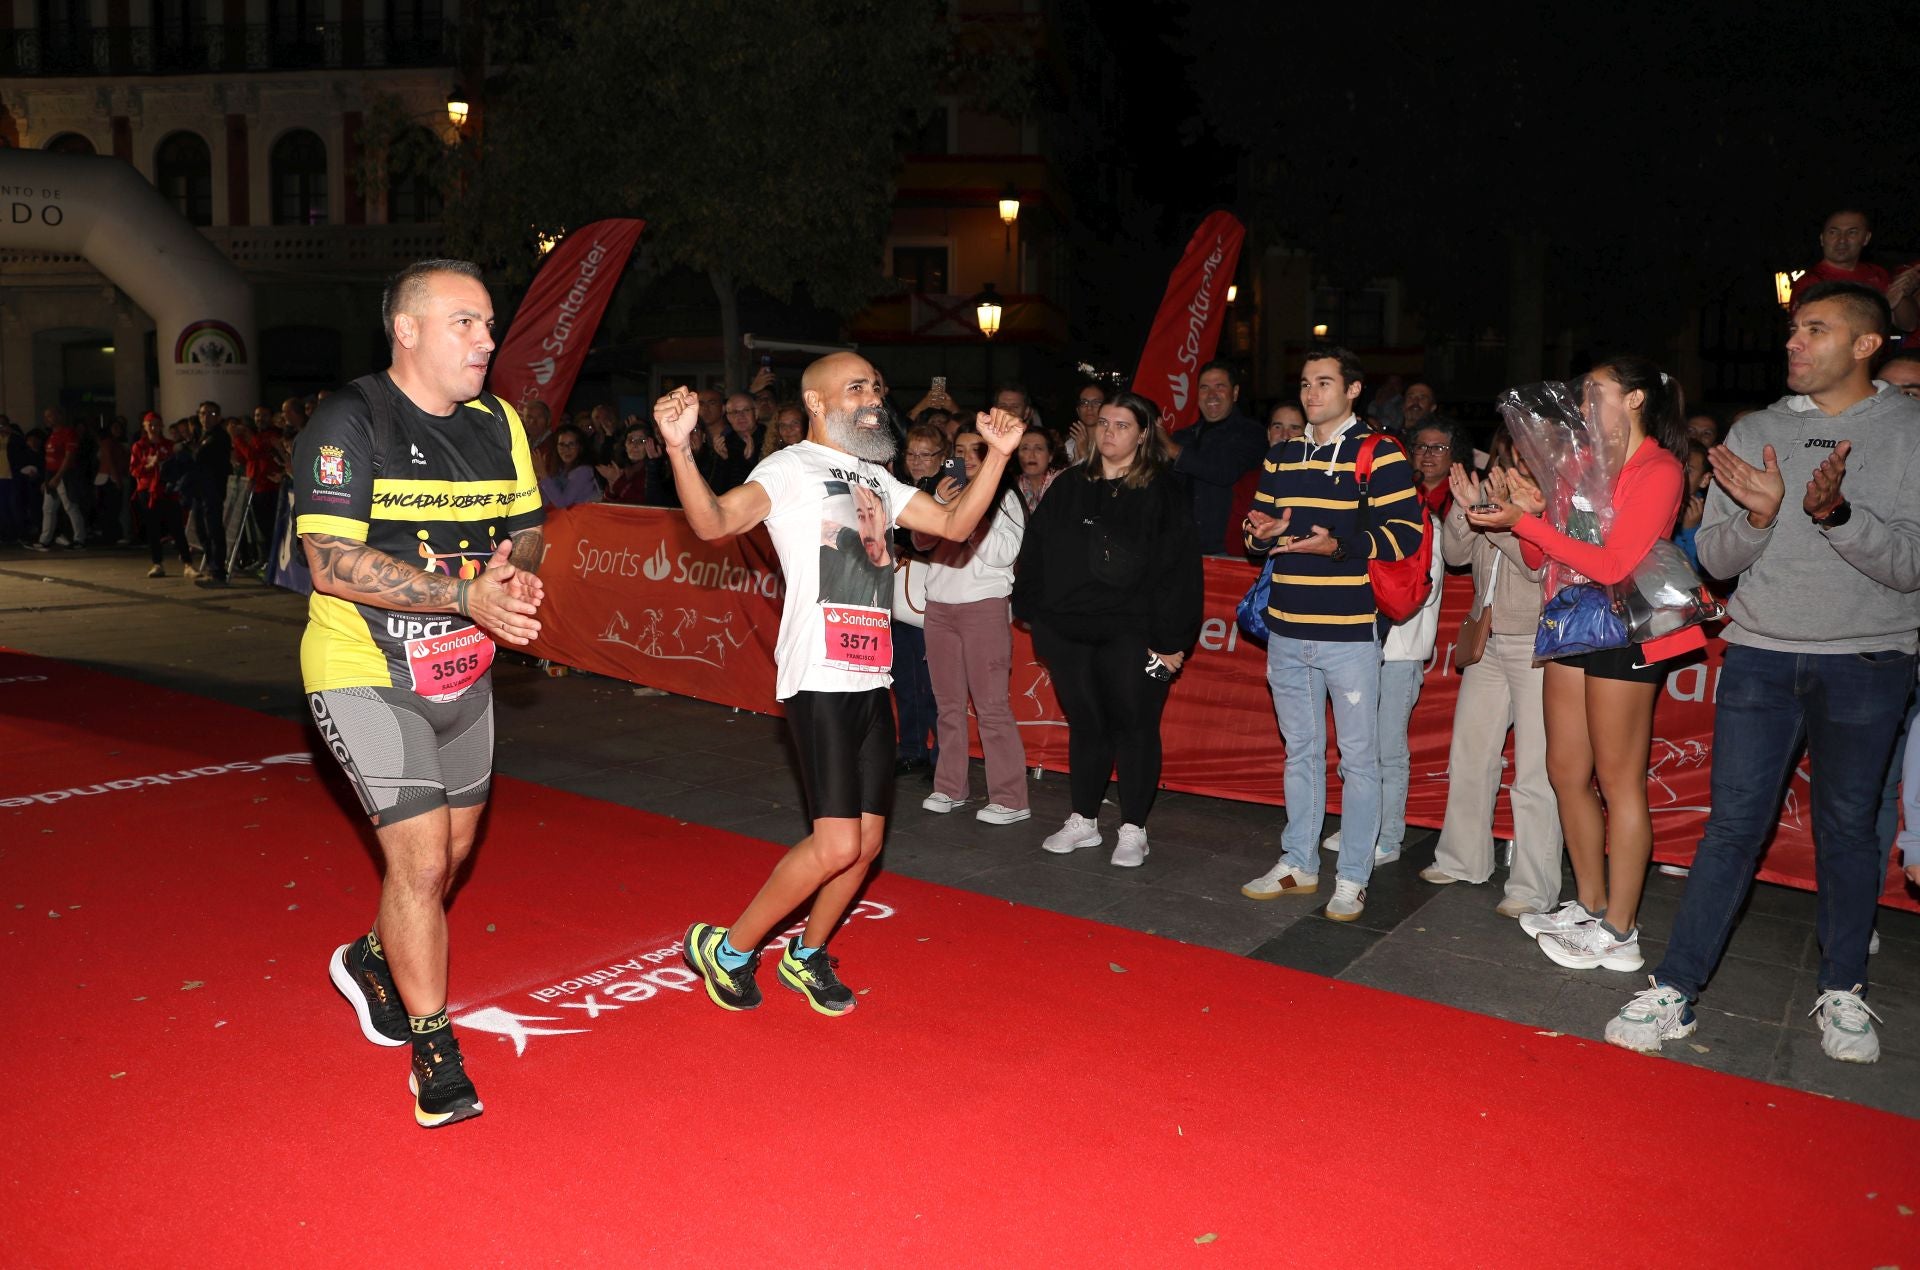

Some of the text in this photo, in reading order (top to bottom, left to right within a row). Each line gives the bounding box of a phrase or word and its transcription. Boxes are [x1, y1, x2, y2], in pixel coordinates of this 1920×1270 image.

[42, 189, 61, 199] DE
[0, 202, 63, 227] DO
[542, 240, 607, 355] Santander
[450, 492, 494, 508] SOBRE
[573, 539, 641, 578] Sports
[673, 551, 786, 599] Santand
[386, 617, 452, 640] UPCT
[840, 632, 878, 651] 3571
[431, 653, 479, 681] 3565
[846, 653, 875, 661] FRANCISCO
[528, 959, 644, 1003] Artificial
